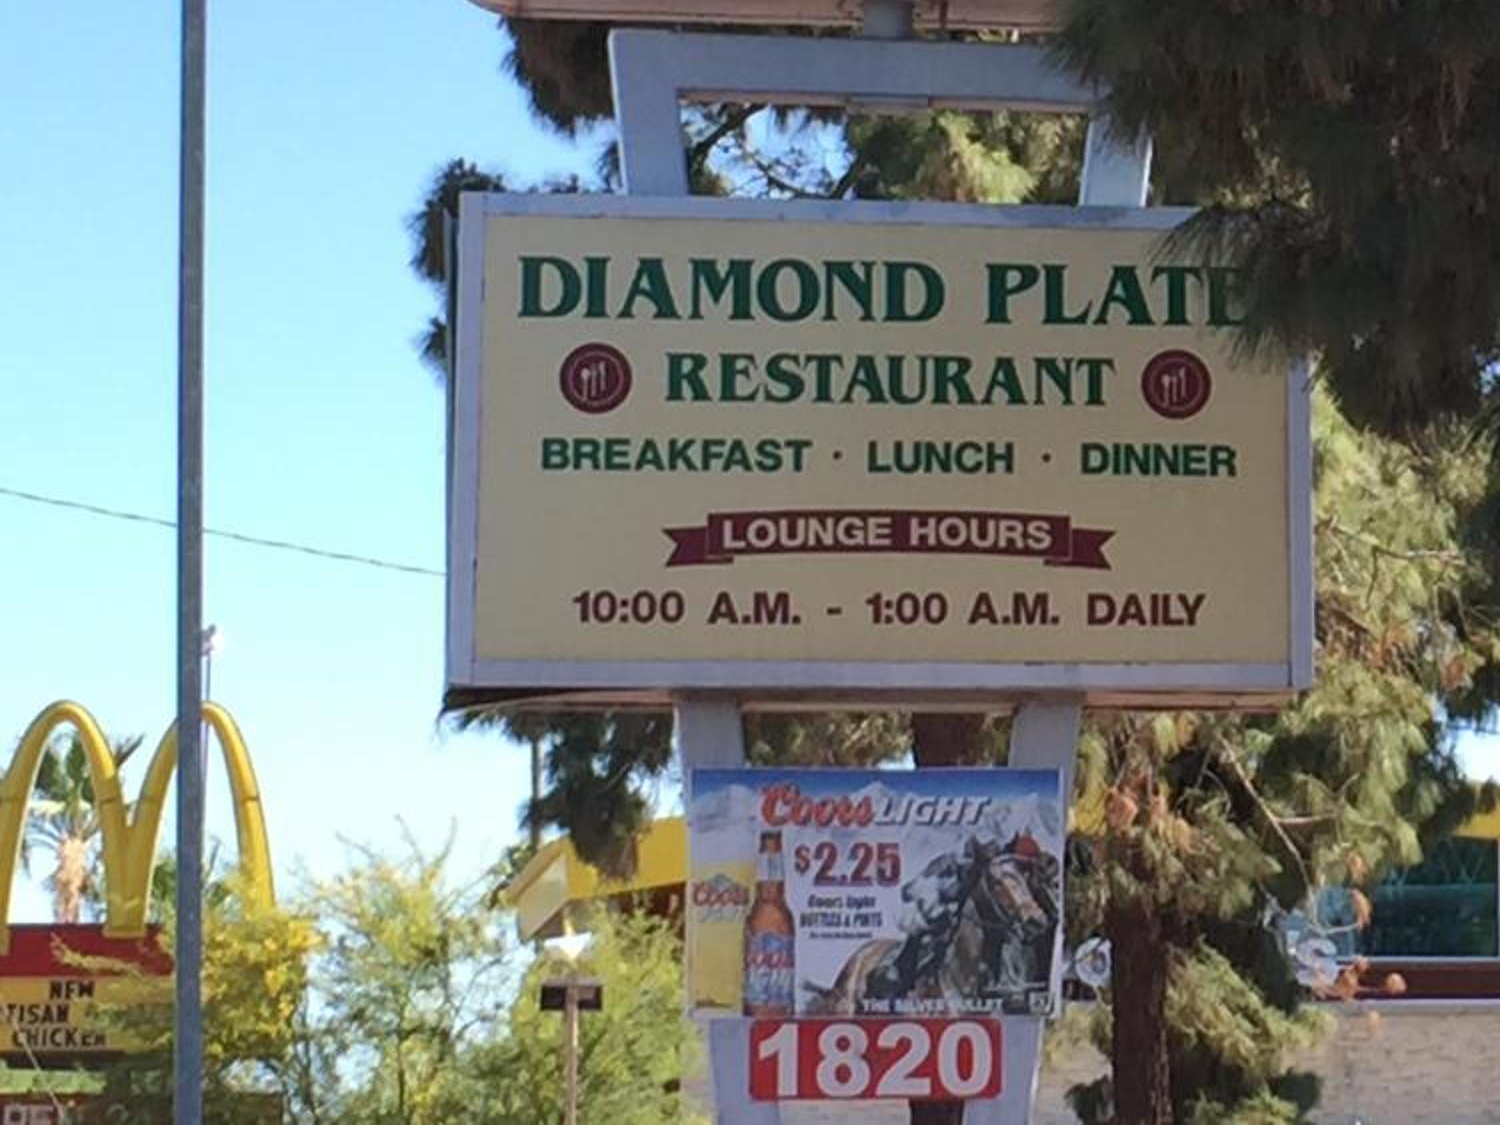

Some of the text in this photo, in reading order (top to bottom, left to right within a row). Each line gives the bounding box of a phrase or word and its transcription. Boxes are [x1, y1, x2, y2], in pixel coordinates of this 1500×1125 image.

[517, 255, 1252, 327] DIAMOND PLATE
[665, 351, 1117, 407] RESTAURANT
[541, 437, 1238, 478] BREAKFAST LUNCH DINNER
[722, 515, 1053, 550] LOUNGE HOURS
[572, 589, 686, 625] 10:00
[707, 590, 802, 626] A.M.
[865, 591, 949, 626] 1:00
[968, 591, 1060, 626] A.M.
[1086, 592, 1206, 627] DAILY
[761, 782, 992, 827] Coors LIGHT
[794, 841, 902, 887] $2.25
[0, 1003, 70, 1025] TISAN
[757, 1020, 993, 1098] 1820
